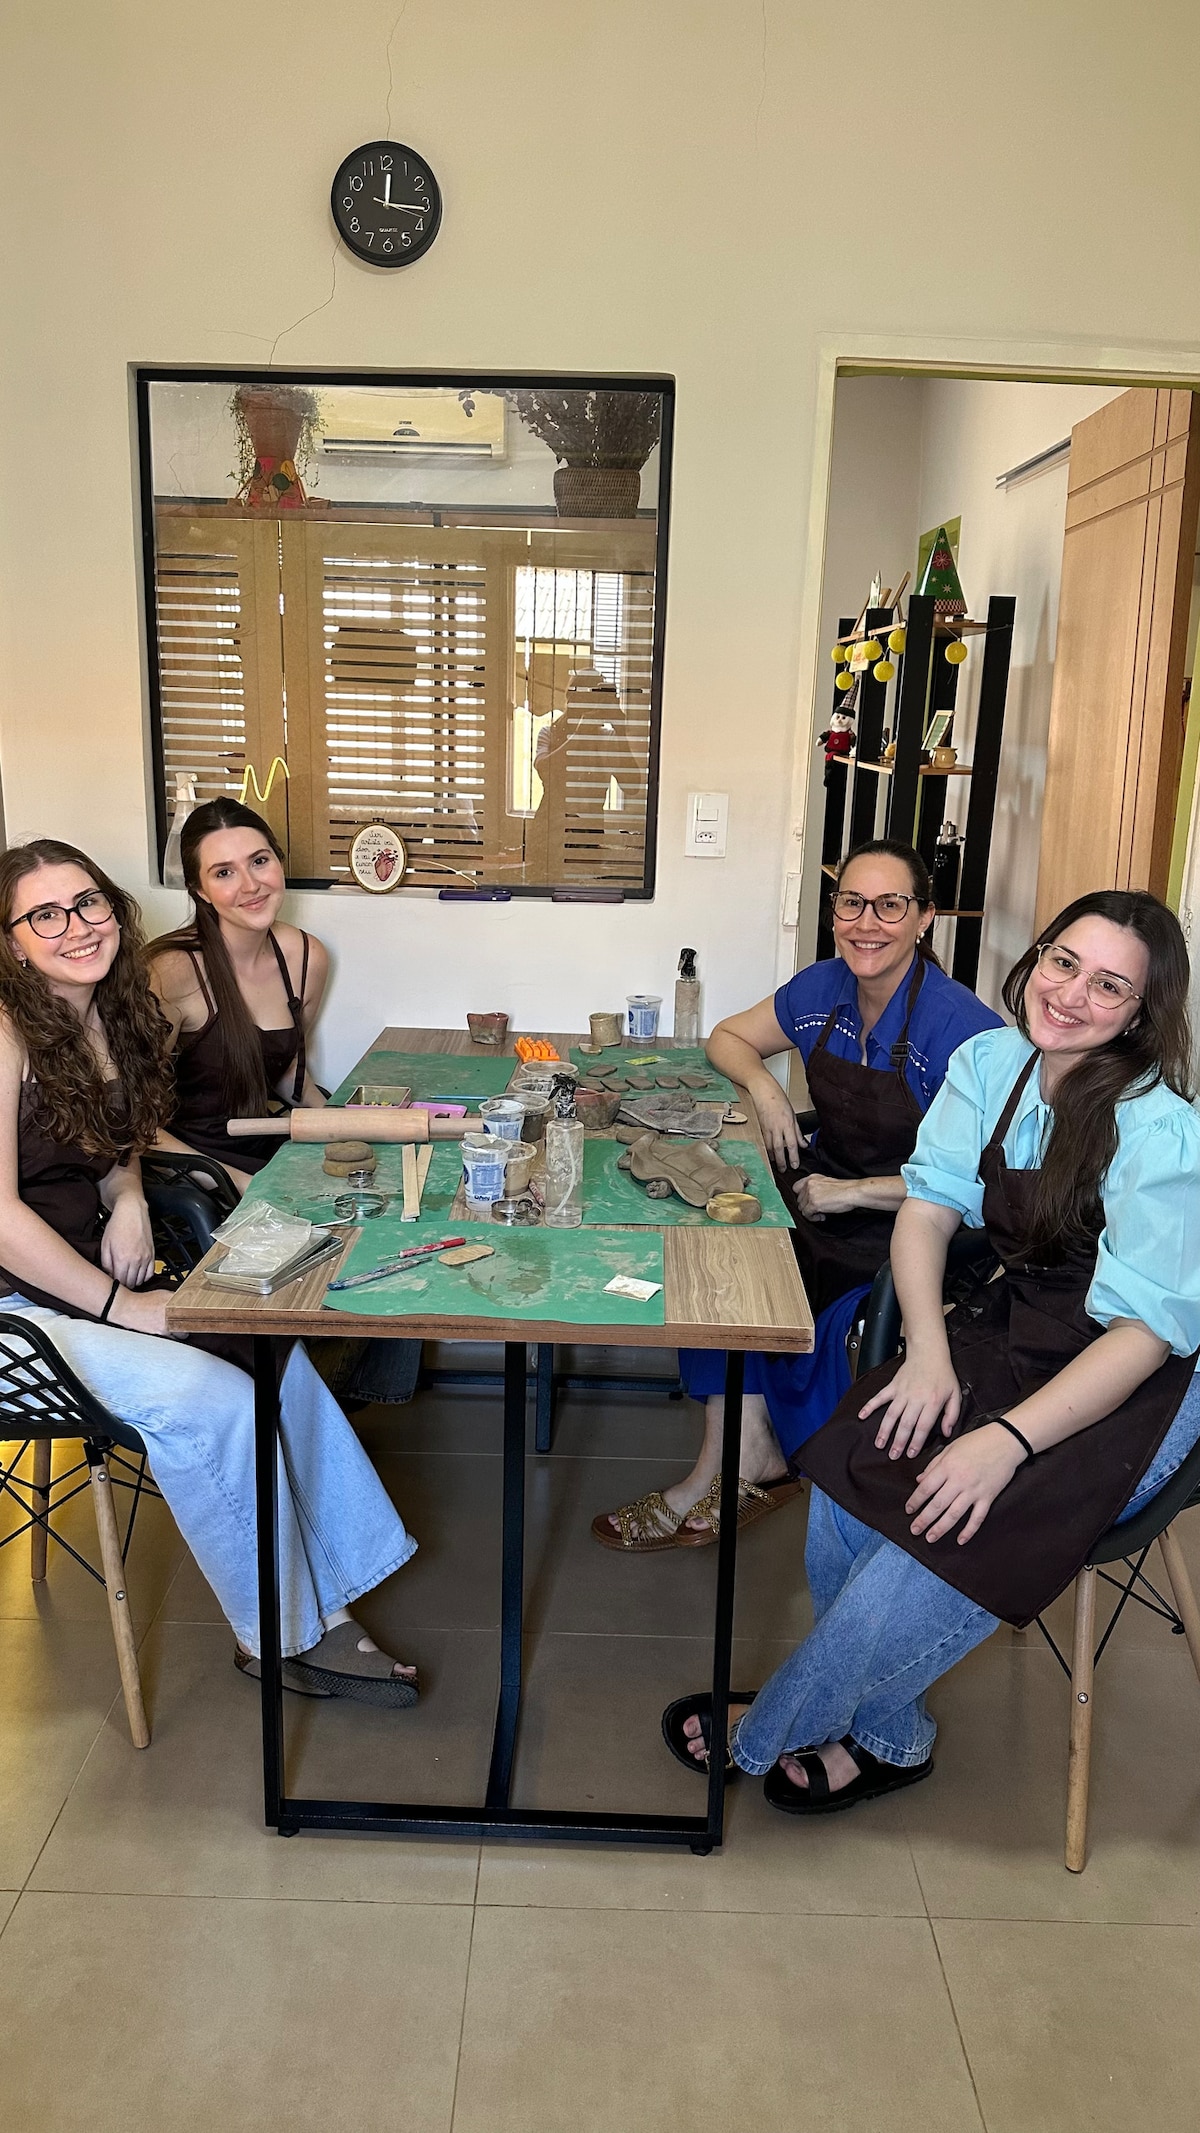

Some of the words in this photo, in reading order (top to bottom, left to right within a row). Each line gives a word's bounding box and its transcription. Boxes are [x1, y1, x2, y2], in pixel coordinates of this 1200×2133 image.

[363, 161, 374, 176] 11
[380, 155, 393, 171] 12
[404, 161, 408, 176] 1
[349, 176, 363, 192] 10
[414, 176, 425, 191] 2
[342, 197, 353, 212] 9
[422, 196, 430, 212] 3
[350, 217, 360, 233] 8
[415, 218, 424, 231] 4
[365, 232, 375, 247] 7
[382, 238, 393, 253] 6
[401, 232, 412, 247] 5
